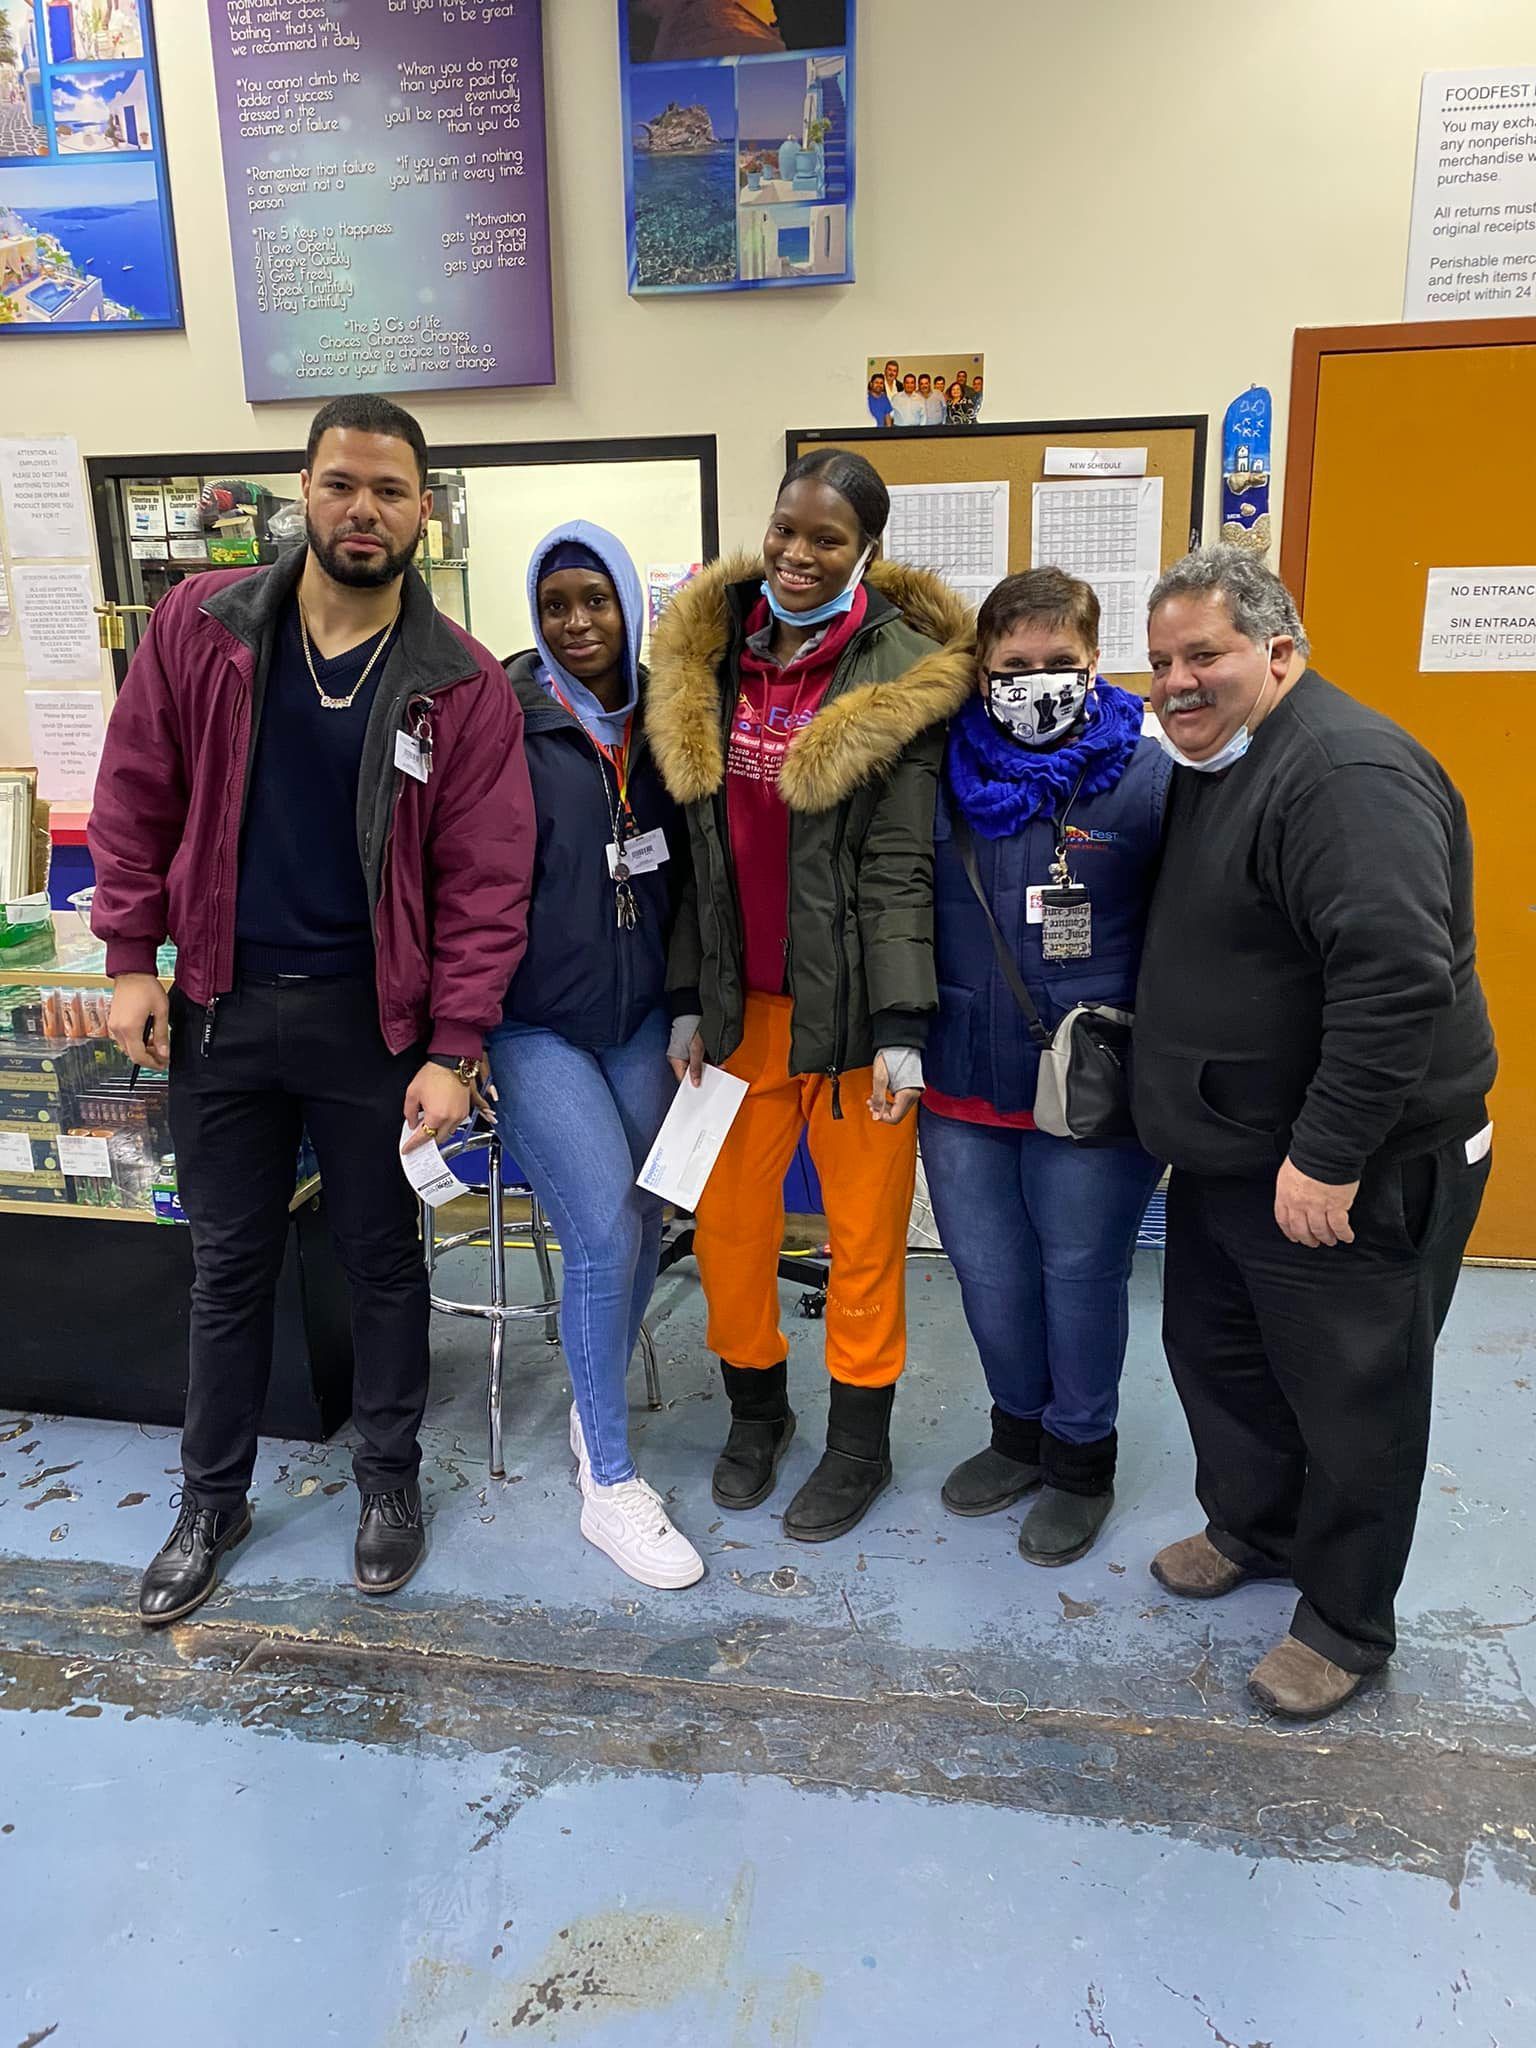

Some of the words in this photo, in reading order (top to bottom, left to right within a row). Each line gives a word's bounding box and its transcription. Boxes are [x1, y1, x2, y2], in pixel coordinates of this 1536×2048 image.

[257, 8, 292, 23] neither
[298, 5, 325, 19] does
[443, 11, 455, 22] to
[460, 6, 477, 20] be
[230, 26, 271, 42] bathing
[318, 18, 340, 36] why
[231, 46, 247, 56] we
[251, 34, 317, 54] recommend
[321, 35, 328, 48] it
[440, 63, 462, 78] you
[466, 57, 484, 72] do
[489, 57, 518, 69] more
[266, 76, 303, 90] cannot
[308, 70, 338, 86] climb
[343, 69, 360, 83] the
[400, 77, 425, 92] than
[470, 71, 495, 91] paid
[237, 93, 272, 107] ladder
[277, 90, 289, 104] of
[294, 90, 334, 102] success
[465, 84, 520, 102] eventually
[1445, 84, 1530, 101] FOODFEST
[239, 105, 280, 122] dressed
[285, 108, 293, 118] in
[299, 103, 316, 117] the
[416, 106, 433, 120] be
[438, 104, 463, 124] paid
[469, 102, 485, 117] for
[491, 103, 520, 114] more
[240, 124, 285, 137] costume
[290, 118, 301, 133] of
[448, 119, 472, 133] than
[477, 120, 498, 136] you
[1443, 120, 1466, 132] You
[1471, 120, 1499, 133] may
[1503, 115, 1536, 128] exch
[1440, 139, 1464, 152] any
[414, 157, 434, 173] you
[439, 154, 459, 166] aim
[465, 152, 476, 165] at
[1439, 151, 1523, 167] merchandise
[317, 161, 338, 176] that
[247, 185, 254, 196] is
[259, 185, 273, 195] an
[313, 179, 331, 191] not
[336, 179, 344, 189] a
[389, 175, 410, 190] you
[415, 169, 429, 183] will
[434, 168, 446, 181] hit
[451, 169, 458, 181] it
[463, 168, 495, 183] every
[1434, 207, 1450, 219] All
[1455, 206, 1500, 218] returns
[280, 225, 289, 240] 5
[293, 225, 318, 241] Keys
[323, 226, 334, 237] to
[441, 232, 465, 248] gets
[469, 230, 490, 245] you
[495, 226, 527, 242] going
[1433, 222, 1480, 237] original
[267, 241, 292, 254] Love
[296, 238, 337, 255] Openly
[472, 240, 494, 255] and
[268, 255, 306, 272] Forgive
[311, 251, 351, 269] Quickly
[444, 260, 467, 276] gets
[472, 259, 492, 274] you
[1430, 255, 1498, 269] Perishable
[1503, 254, 1536, 265] merc
[270, 269, 295, 283] Give
[300, 266, 334, 284] Freely
[1428, 274, 1453, 286] and
[1457, 272, 1488, 284] fresh
[1493, 271, 1527, 282] items
[272, 283, 304, 297] Speak
[1427, 289, 1470, 303] receipt
[1474, 288, 1511, 300] within
[1515, 286, 1531, 298] 24
[372, 318, 381, 332] 3
[409, 316, 421, 330] of
[299, 350, 319, 363] You
[324, 351, 347, 362] must
[352, 348, 381, 361] make
[386, 350, 394, 359] a
[439, 344, 449, 355] to
[455, 341, 478, 354] take
[483, 344, 492, 353] a
[296, 366, 334, 378] chance
[355, 363, 379, 380] your
[383, 359, 398, 373] life
[403, 358, 417, 371] will
[421, 359, 451, 370] never
[1451, 585, 1470, 596] NO
[1473, 585, 1535, 596] ENTRANC
[1450, 618, 1471, 628] SIN
[1475, 617, 1536, 628] ENTRADA
[1485, 633, 1536, 645] INTERDI
